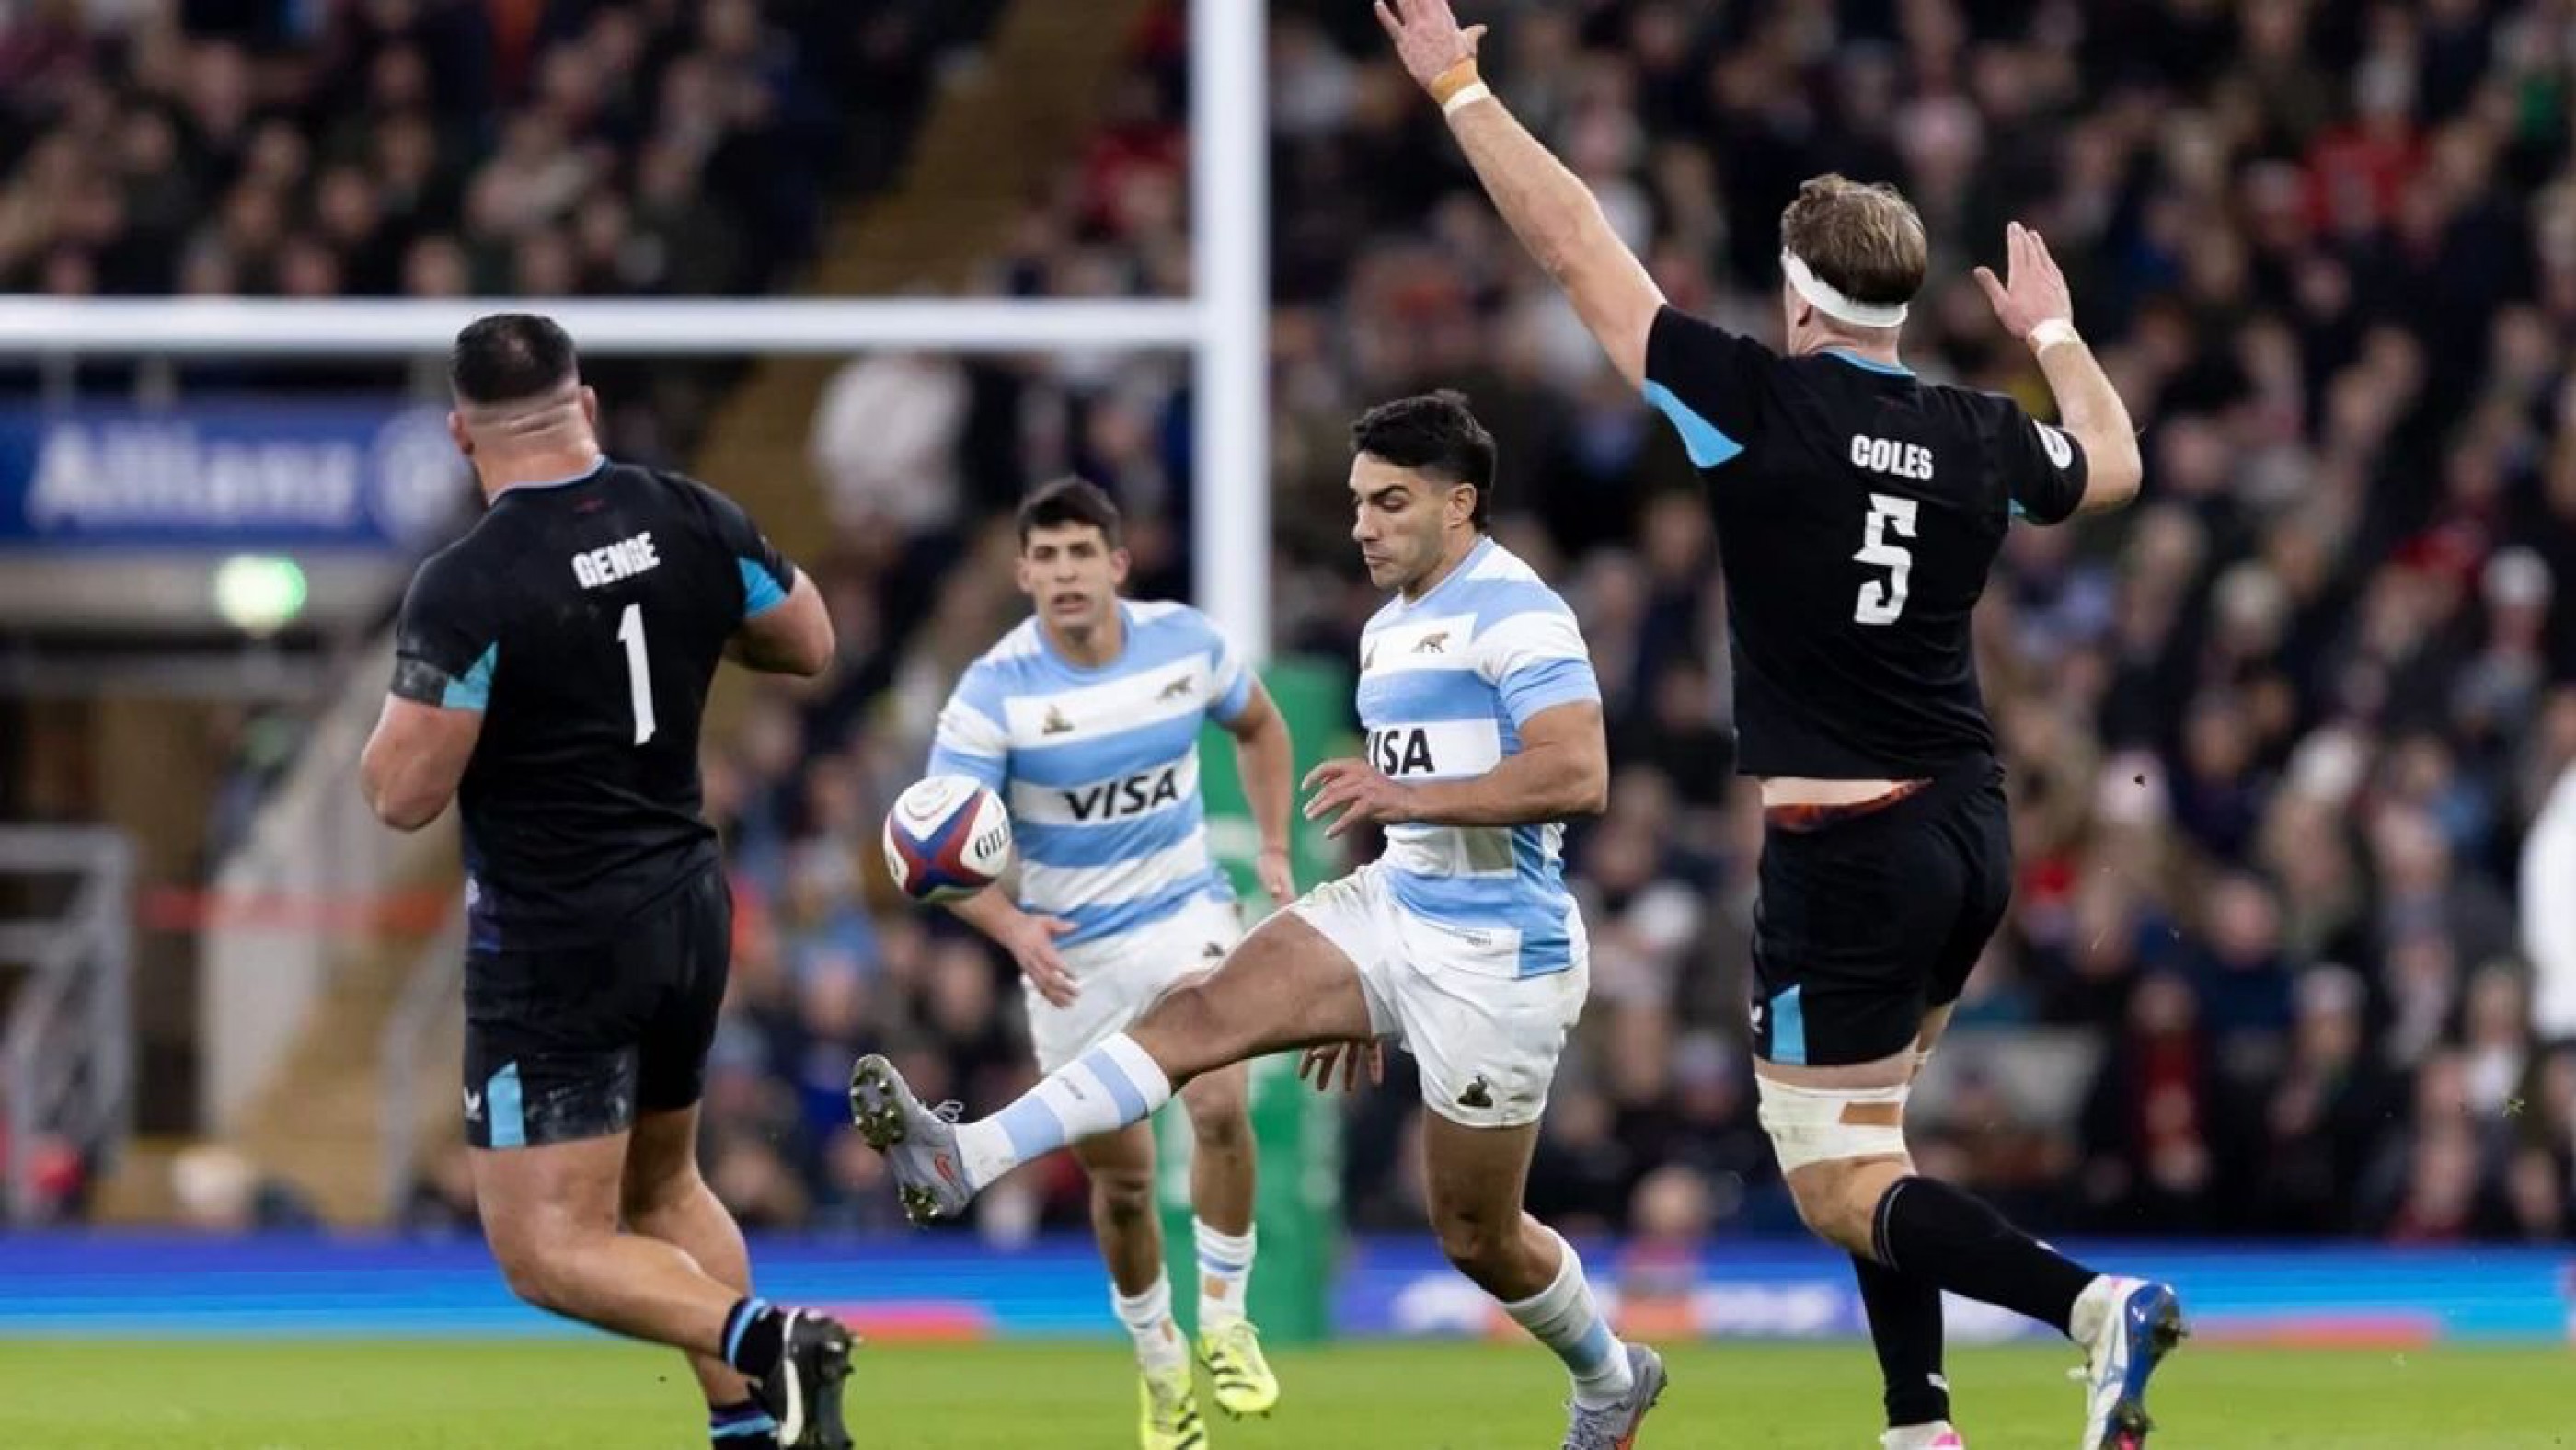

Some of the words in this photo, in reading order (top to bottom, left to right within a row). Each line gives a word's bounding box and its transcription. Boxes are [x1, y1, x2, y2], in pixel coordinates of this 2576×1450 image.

[1852, 434, 1934, 480] COLES
[572, 532, 661, 589] GENGE
[1852, 493, 1918, 625] 5
[617, 603, 656, 745] 1
[1062, 768, 1177, 821] VISA
